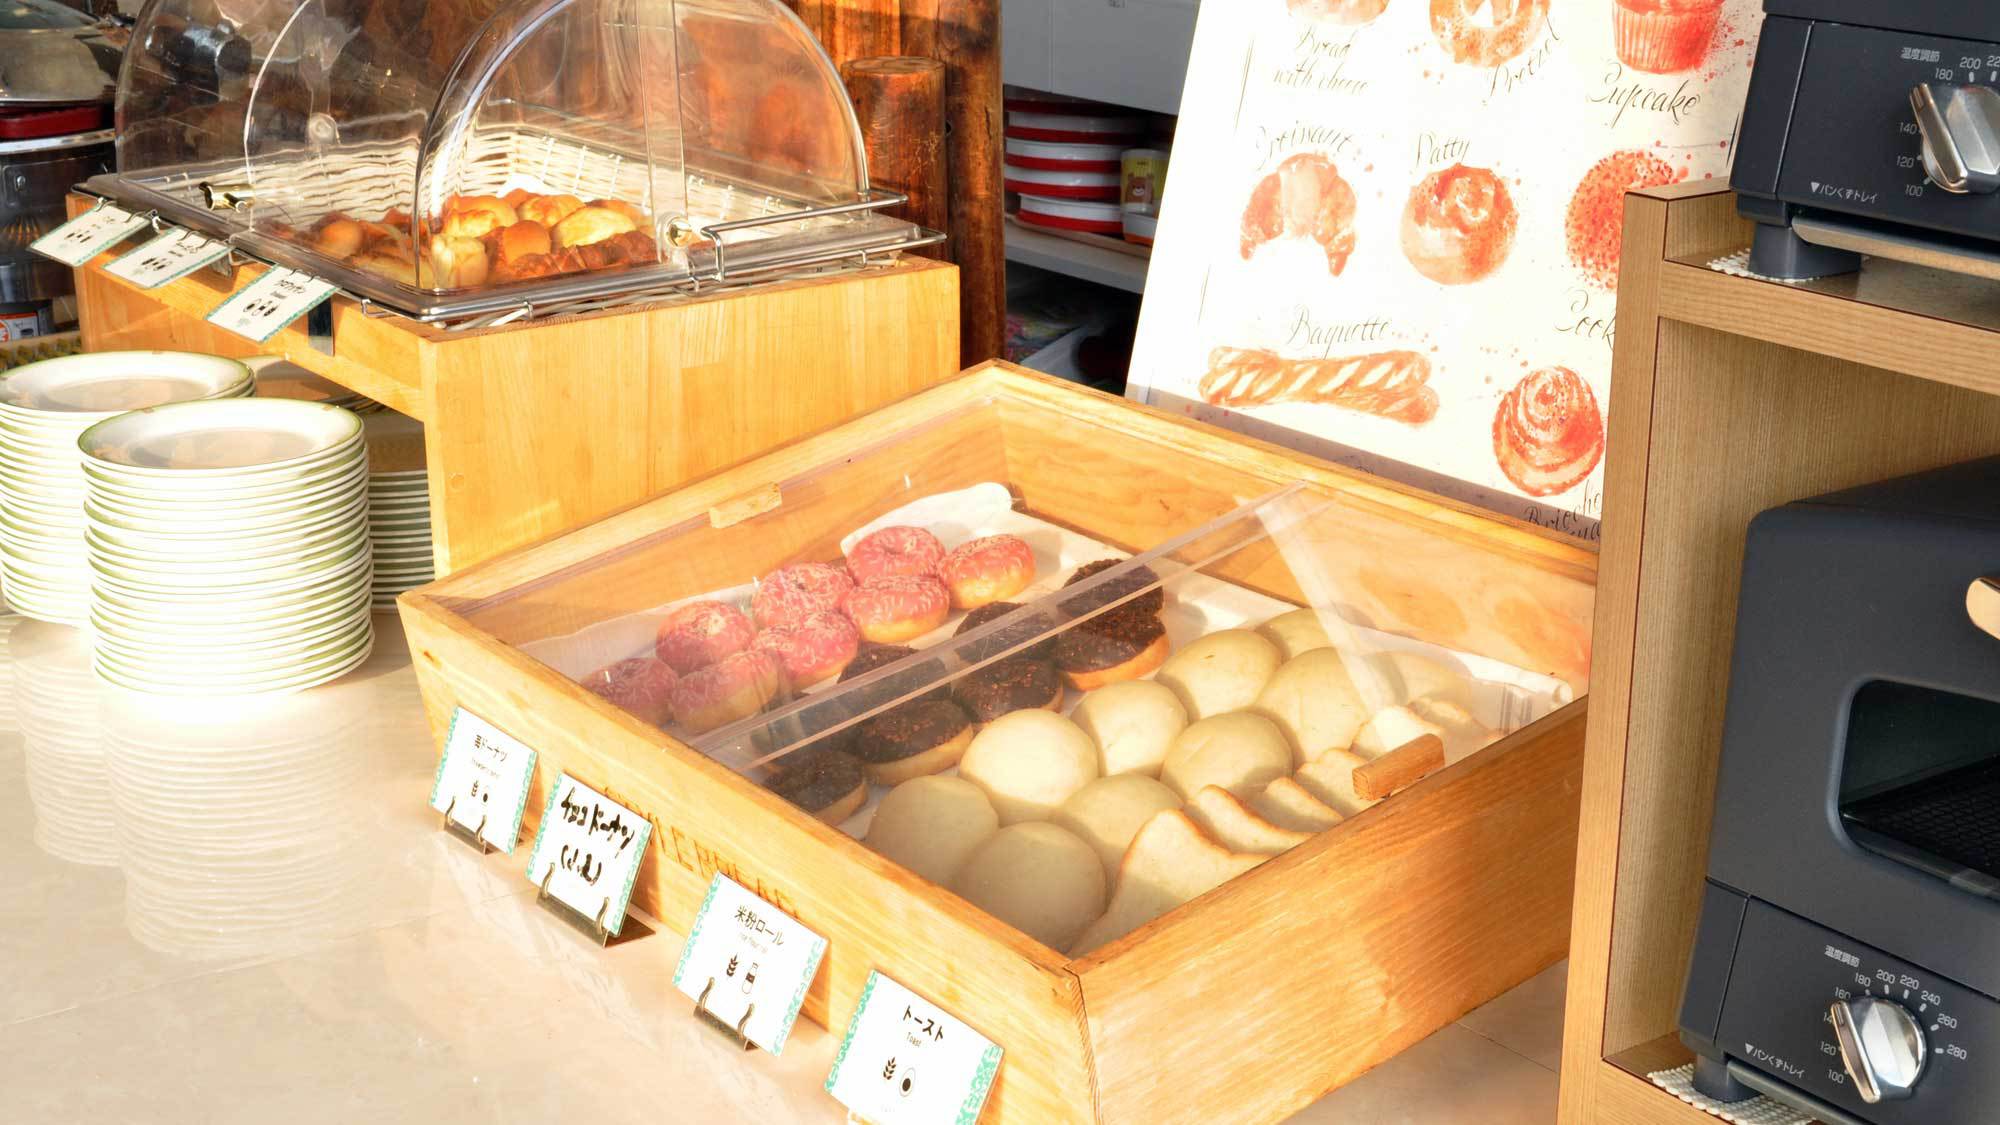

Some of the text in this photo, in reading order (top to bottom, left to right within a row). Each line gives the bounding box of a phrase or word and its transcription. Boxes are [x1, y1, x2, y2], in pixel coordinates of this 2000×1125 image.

[1901, 47, 1940, 62] 温度調節
[1934, 68, 1953, 81] 180
[1959, 56, 1981, 70] 200
[1586, 62, 1700, 129] Cupcake
[1900, 122, 1917, 135] 140
[1896, 156, 1914, 168] 120
[1905, 184, 1923, 197] 100
[1286, 304, 1392, 361] Baguette
[734, 905, 784, 946] 米粉ロール
[903, 1004, 943, 1041] トースト
[1834, 969, 1967, 1060] 160 180 200 220 240 260 280
[1820, 1041, 1836, 1056] 120
[1828, 1069, 1844, 1084] 100
